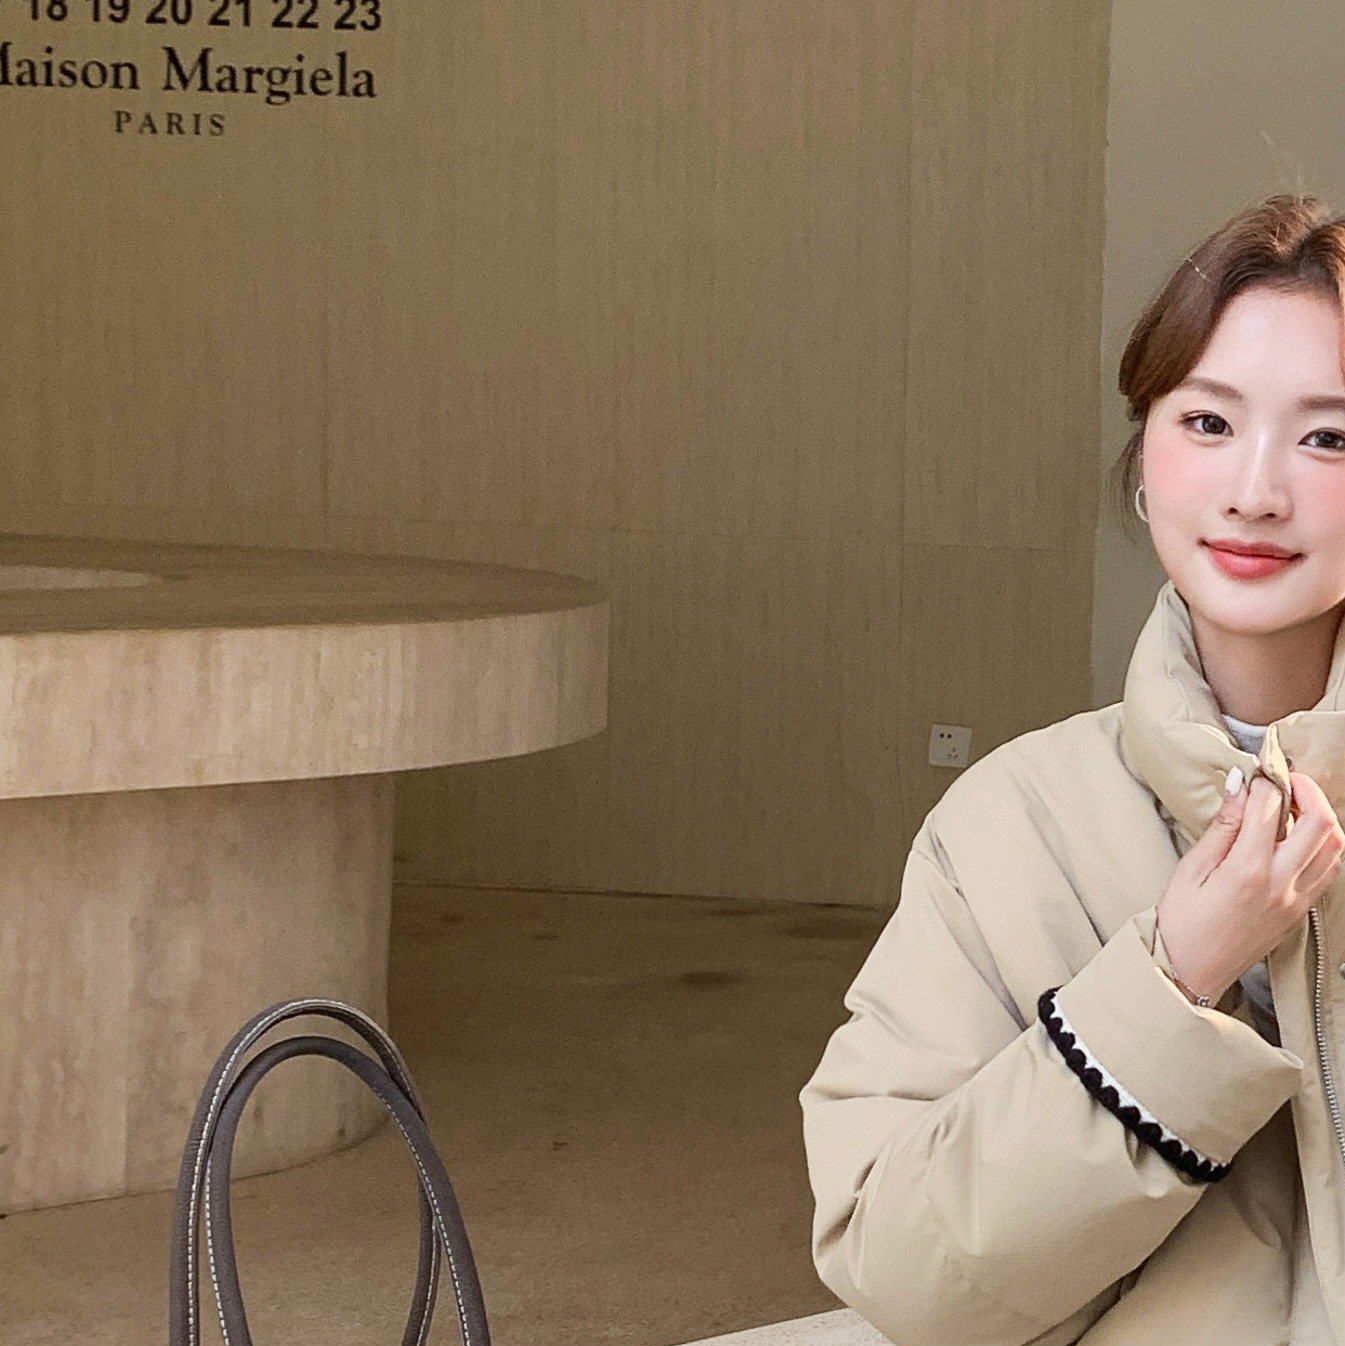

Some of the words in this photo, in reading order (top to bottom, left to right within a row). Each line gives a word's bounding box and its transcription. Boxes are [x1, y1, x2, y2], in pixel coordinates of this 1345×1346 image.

[25, 0, 69, 21] 18
[86, 0, 131, 23] 19
[145, 0, 193, 25] 20
[208, 0, 251, 27] 21
[271, 0, 320, 29] 22
[333, 0, 382, 31] 23
[0, 41, 141, 90] aison
[161, 46, 378, 106] Margiela
[114, 110, 227, 137] PARIS
